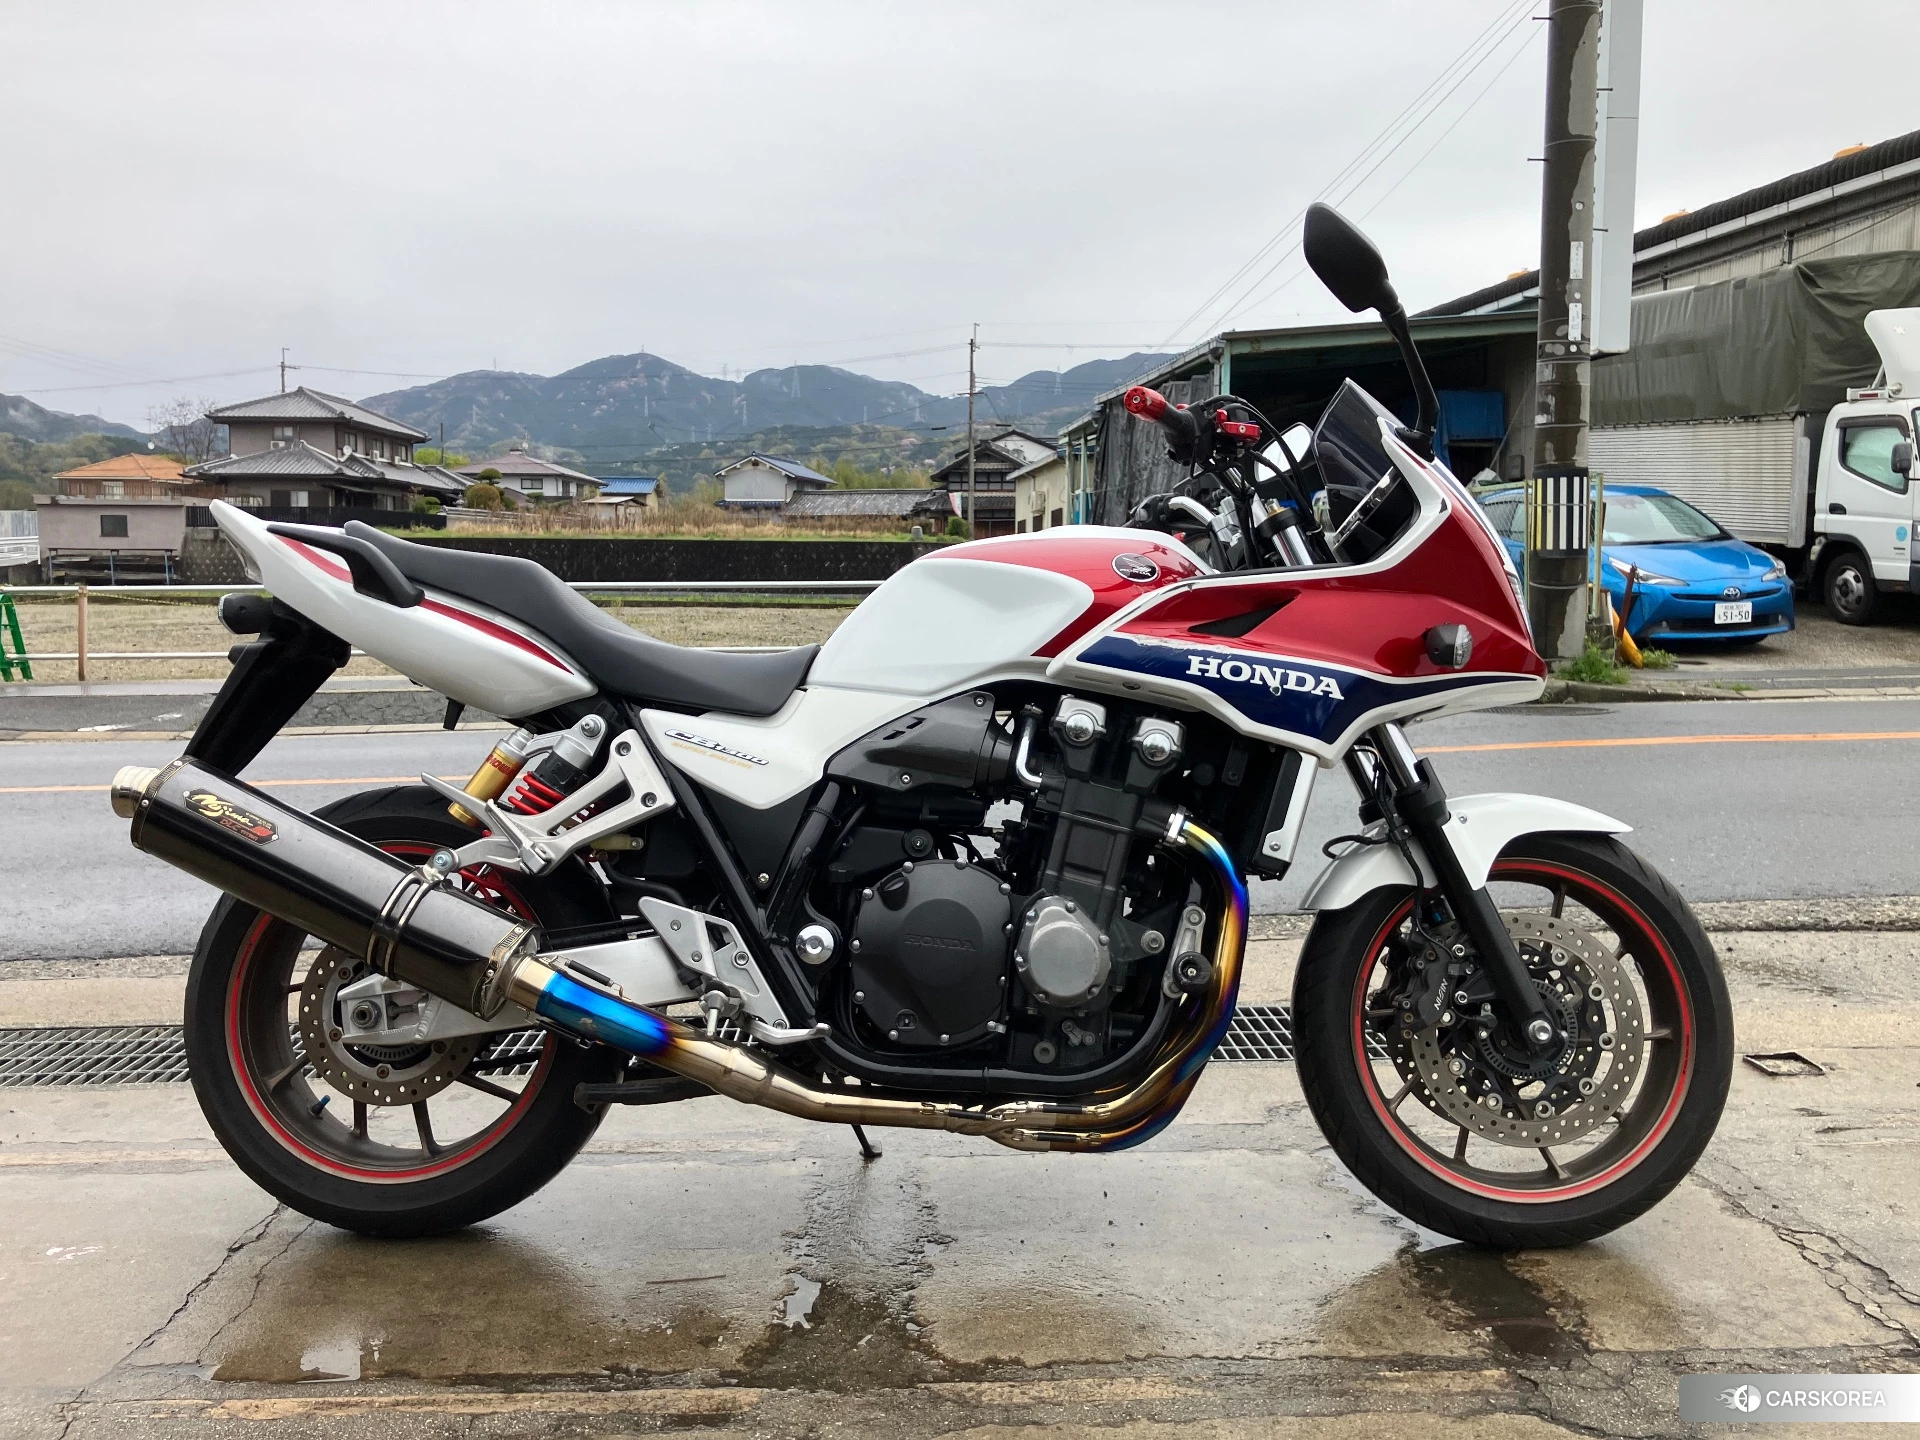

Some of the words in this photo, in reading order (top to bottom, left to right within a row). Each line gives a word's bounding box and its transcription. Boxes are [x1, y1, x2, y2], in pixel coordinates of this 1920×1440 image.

[1723, 611, 1750, 621] 51-50
[1186, 655, 1345, 700] HONDA
[904, 933, 976, 951] HONDA
